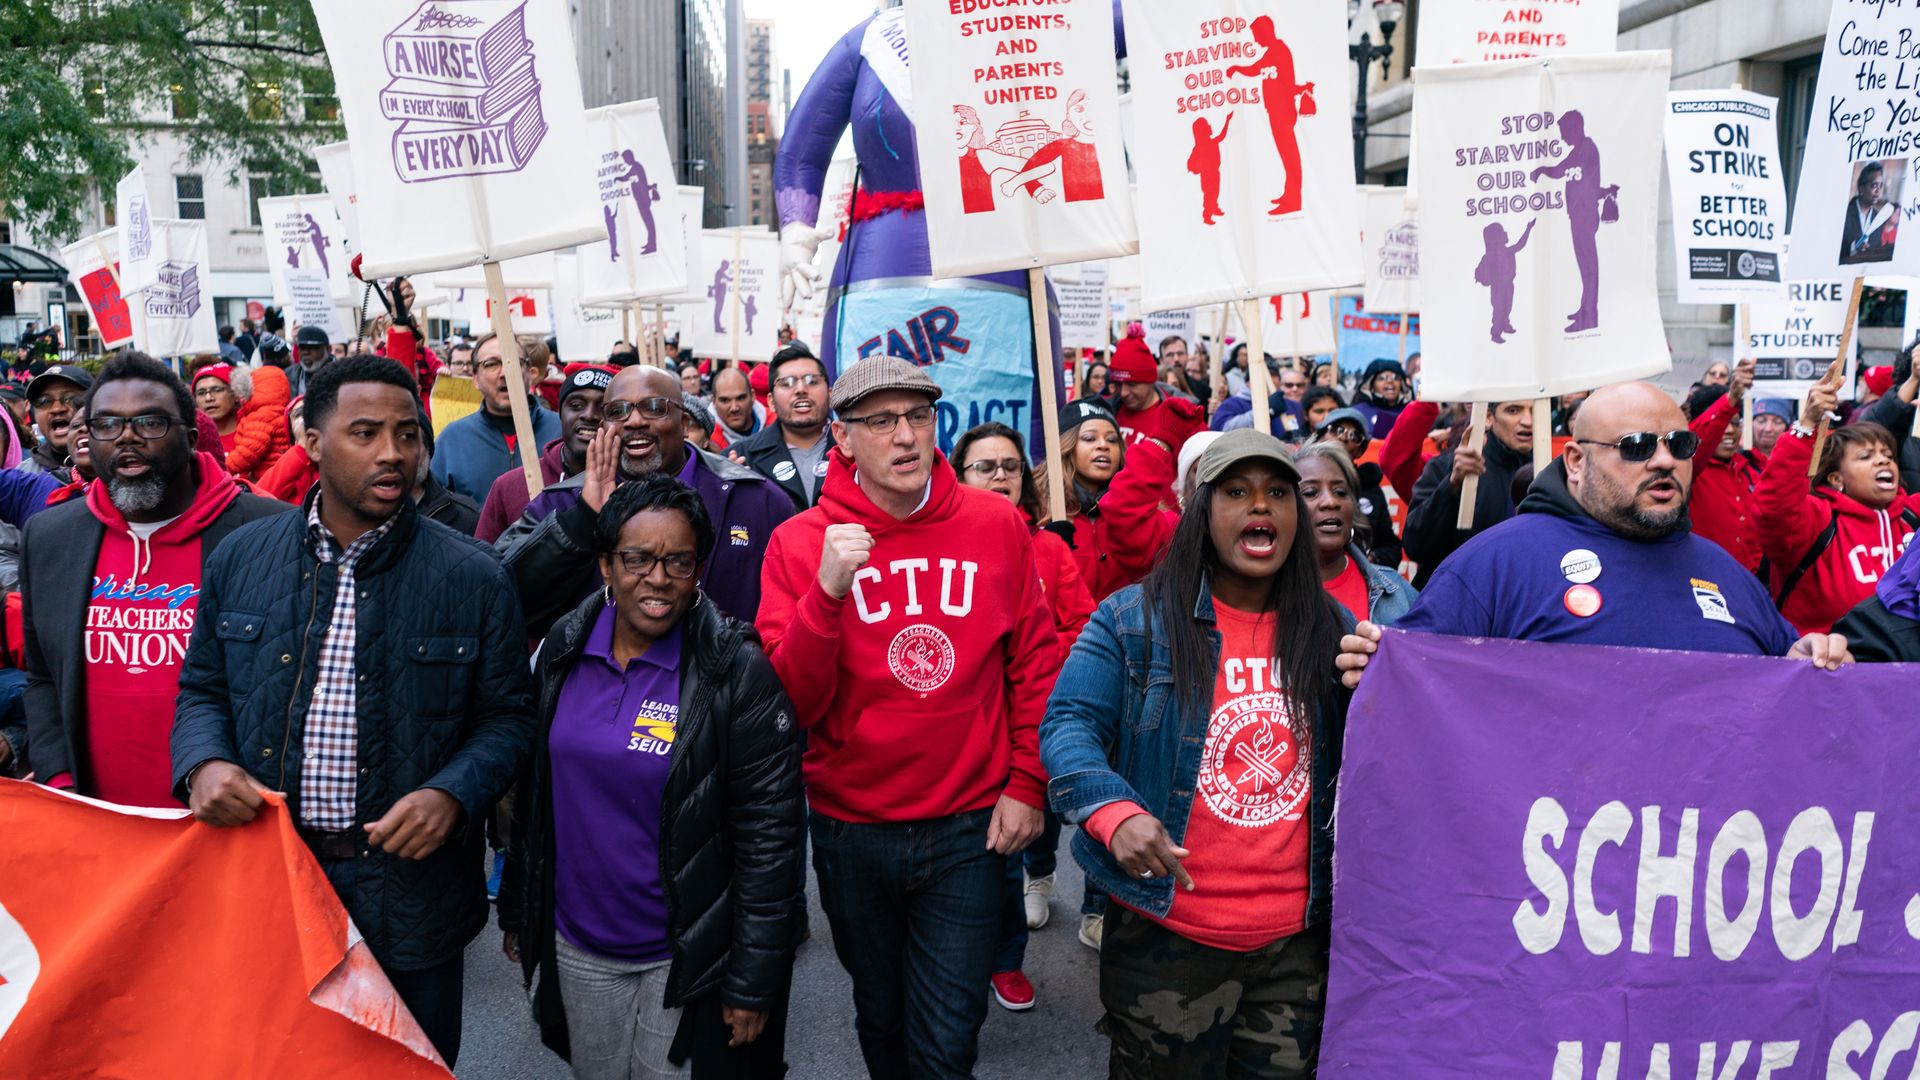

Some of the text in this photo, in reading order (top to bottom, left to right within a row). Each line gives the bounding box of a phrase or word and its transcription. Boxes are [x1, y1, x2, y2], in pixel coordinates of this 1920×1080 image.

[960, 14, 1072, 37] STUDENTS,
[1200, 17, 1247, 39] STOP
[1503, 9, 1543, 24] AND
[994, 38, 1038, 57] AND
[1477, 31, 1567, 47] PARENTS
[1839, 20, 1888, 56] Come
[395, 41, 478, 80] A NURSE
[1164, 41, 1257, 70] STARVING
[974, 61, 1064, 84] PARENTS
[1184, 69, 1224, 90] OUR
[1856, 60, 1920, 97] the Li
[983, 85, 1058, 105] UNITED
[1176, 87, 1261, 114] SCHOOLS
[385, 98, 475, 121] IN EVERY SCHOOL
[1674, 102, 1769, 118] CHICAGO PUBLIC SCHOOLS
[1828, 95, 1875, 134] Keep
[1501, 112, 1555, 135] STOP
[1714, 123, 1749, 149] ON
[403, 129, 504, 172] EVERY DAY
[601, 151, 619, 163] STOP
[1455, 139, 1563, 167] STARVING
[597, 163, 627, 177] ARVING
[1689, 150, 1769, 179] STRIKE
[599, 179, 613, 190] OUR
[1477, 171, 1526, 191] OUR
[1731, 182, 1744, 190] for
[600, 187, 630, 201] CHOOLS
[1465, 191, 1564, 217] SCHOOLS
[1701, 195, 1768, 216] BETTER
[1692, 218, 1774, 240] SCHOOLS
[1789, 283, 1843, 301] RIKE
[149, 303, 174, 315] EVERY
[583, 308, 614, 322] School
[1150, 321, 1187, 331] United!
[1785, 317, 1813, 331] MY
[857, 305, 971, 368] FAIR
[1751, 334, 1843, 348] STUDENTS
[937, 398, 1028, 459] RACT
[1848, 544, 1905, 584] CT
[91, 573, 200, 610] hicag
[852, 557, 979, 625] CTU
[86, 605, 195, 631] TEACHERS
[84, 630, 192, 667] UNION
[638, 708, 667, 721] LOCAL
[641, 699, 679, 715] LEADE
[627, 736, 672, 756] SEIU
[1200, 697, 1292, 786] CHICAGO TEACH
[1214, 712, 1259, 769] ORGANIZE
[1216, 771, 1238, 799] EST.
[1241, 793, 1270, 805] 1937
[1210, 792, 1240, 817] AFT
[1242, 799, 1290, 821] LOCAL
[1512, 796, 1876, 961] SCHOOL
